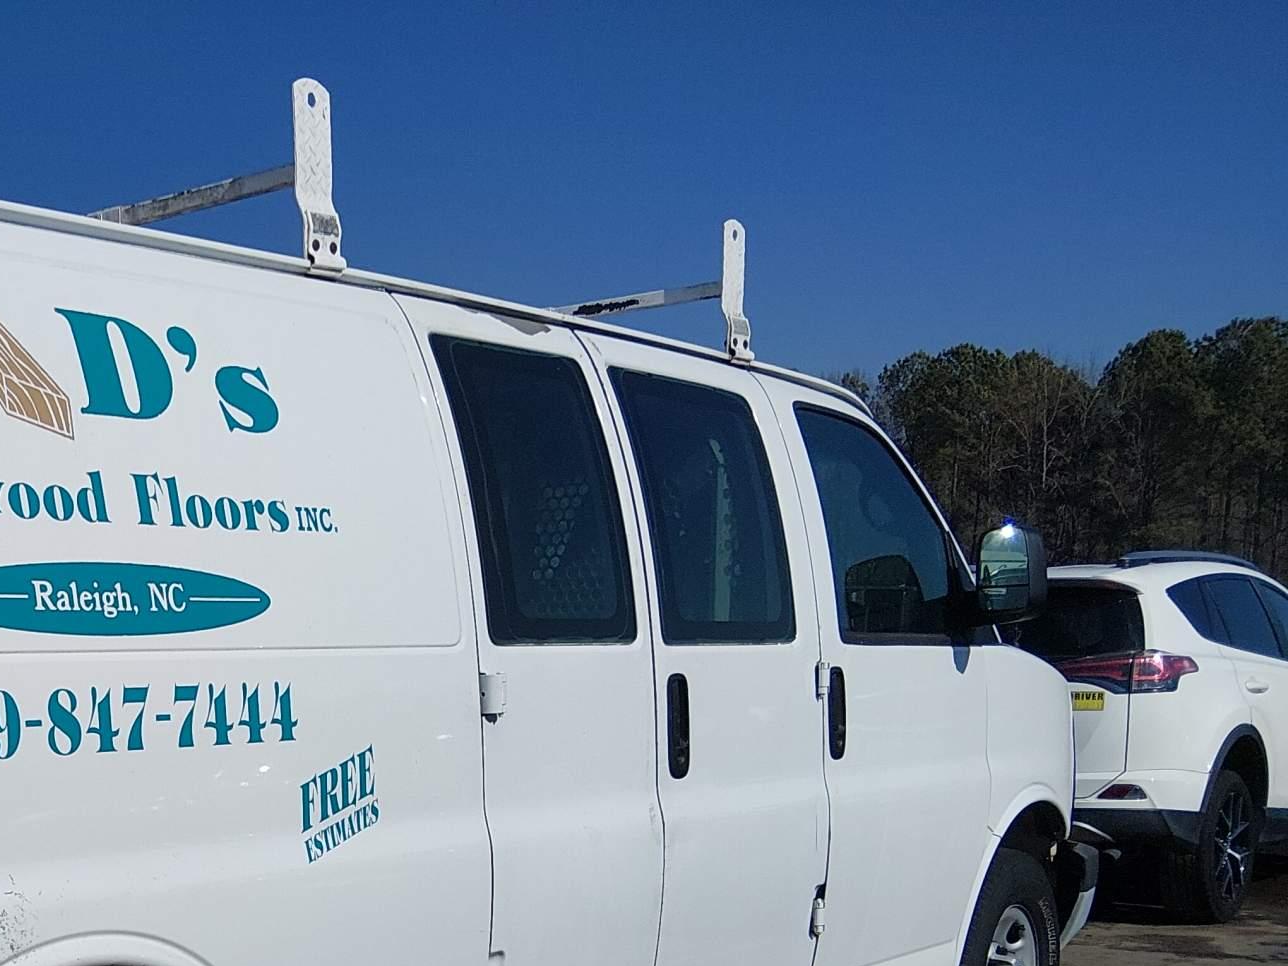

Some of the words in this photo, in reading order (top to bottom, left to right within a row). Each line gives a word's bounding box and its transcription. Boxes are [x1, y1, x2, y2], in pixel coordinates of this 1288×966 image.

[54, 307, 280, 435] D's
[130, 472, 290, 534] Floors
[296, 506, 340, 534] INC.
[31, 580, 139, 618] Raleigh,
[147, 582, 187, 612] NC
[1071, 691, 1103, 700] RIVER
[299, 745, 375, 834] FREE
[305, 800, 380, 865] ESTIMATES
